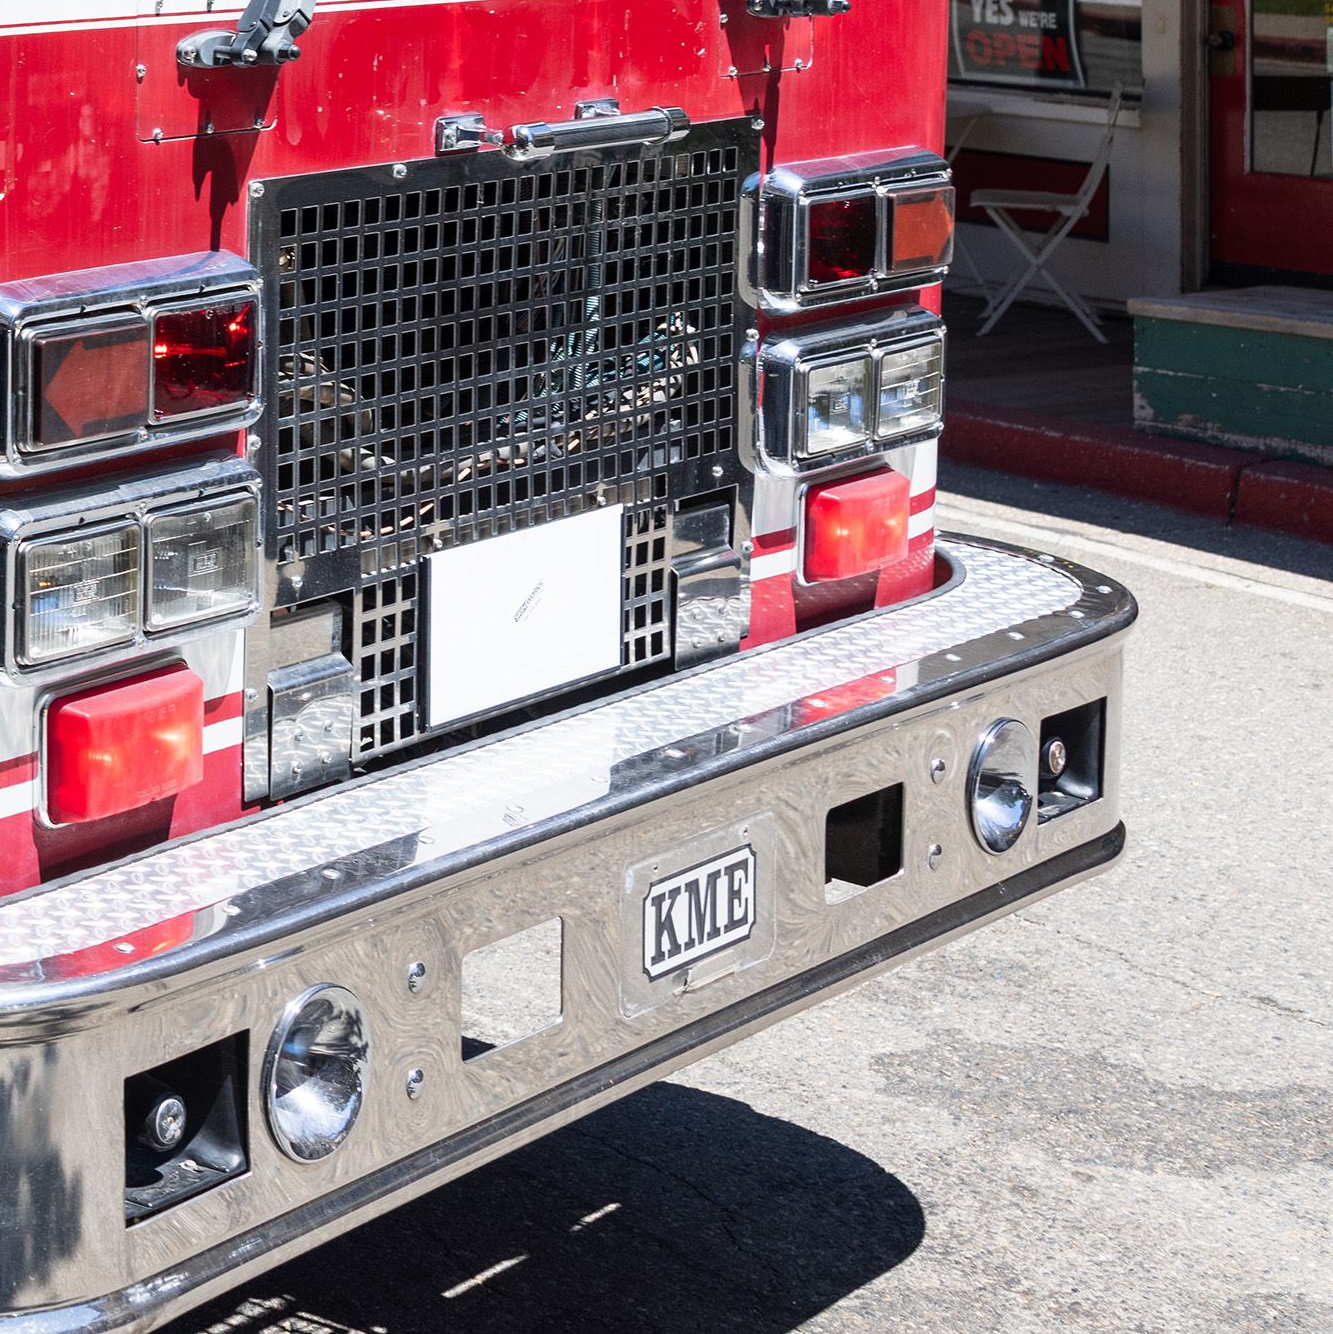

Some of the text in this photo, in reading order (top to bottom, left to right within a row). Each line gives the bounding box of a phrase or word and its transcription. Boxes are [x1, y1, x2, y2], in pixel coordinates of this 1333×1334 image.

[1018, 10, 1058, 29] WE'RE
[966, 30, 1071, 72] OPEN
[650, 857, 750, 967] KME
